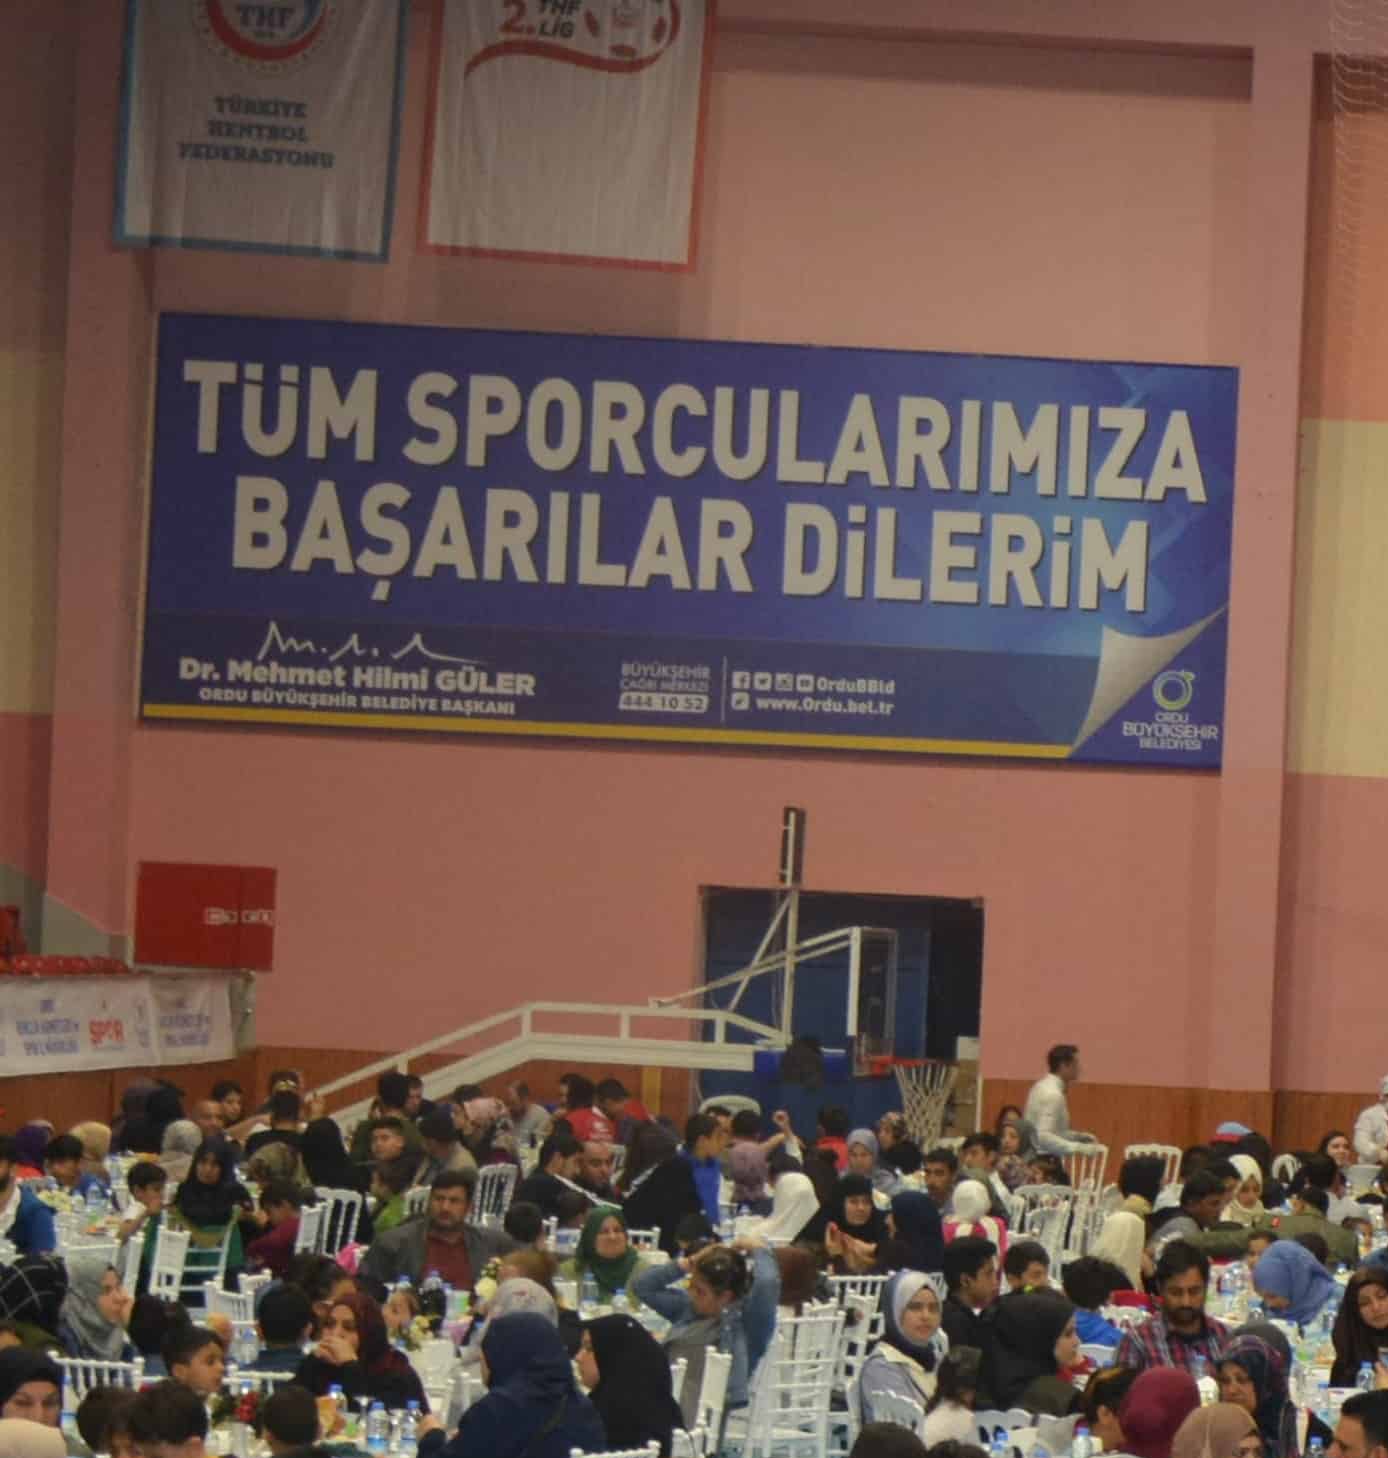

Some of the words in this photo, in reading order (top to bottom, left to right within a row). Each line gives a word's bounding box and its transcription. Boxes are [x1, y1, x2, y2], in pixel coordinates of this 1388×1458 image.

[215, 95, 307, 118] TÜRKİYE
[208, 119, 308, 143] HENTBOL
[178, 142, 335, 168] FEDERASYONU
[184, 360, 377, 462] TÜM
[402, 371, 1207, 504] SPORCULARIMIZA
[232, 475, 755, 602] BAŞARILAR
[179, 658, 220, 681] Dr.
[227, 660, 346, 687] Mehmet
[353, 665, 428, 690] Hilmi
[435, 666, 535, 696] GÜLER
[199, 688, 243, 702] ORDU
[251, 689, 357, 709] BÜYÜKŞEHİR
[361, 693, 438, 712] BELEDİYE
[441, 697, 515, 716] BAŞKANI
[661, 697, 679, 708] 10
[684, 698, 704, 709] 52
